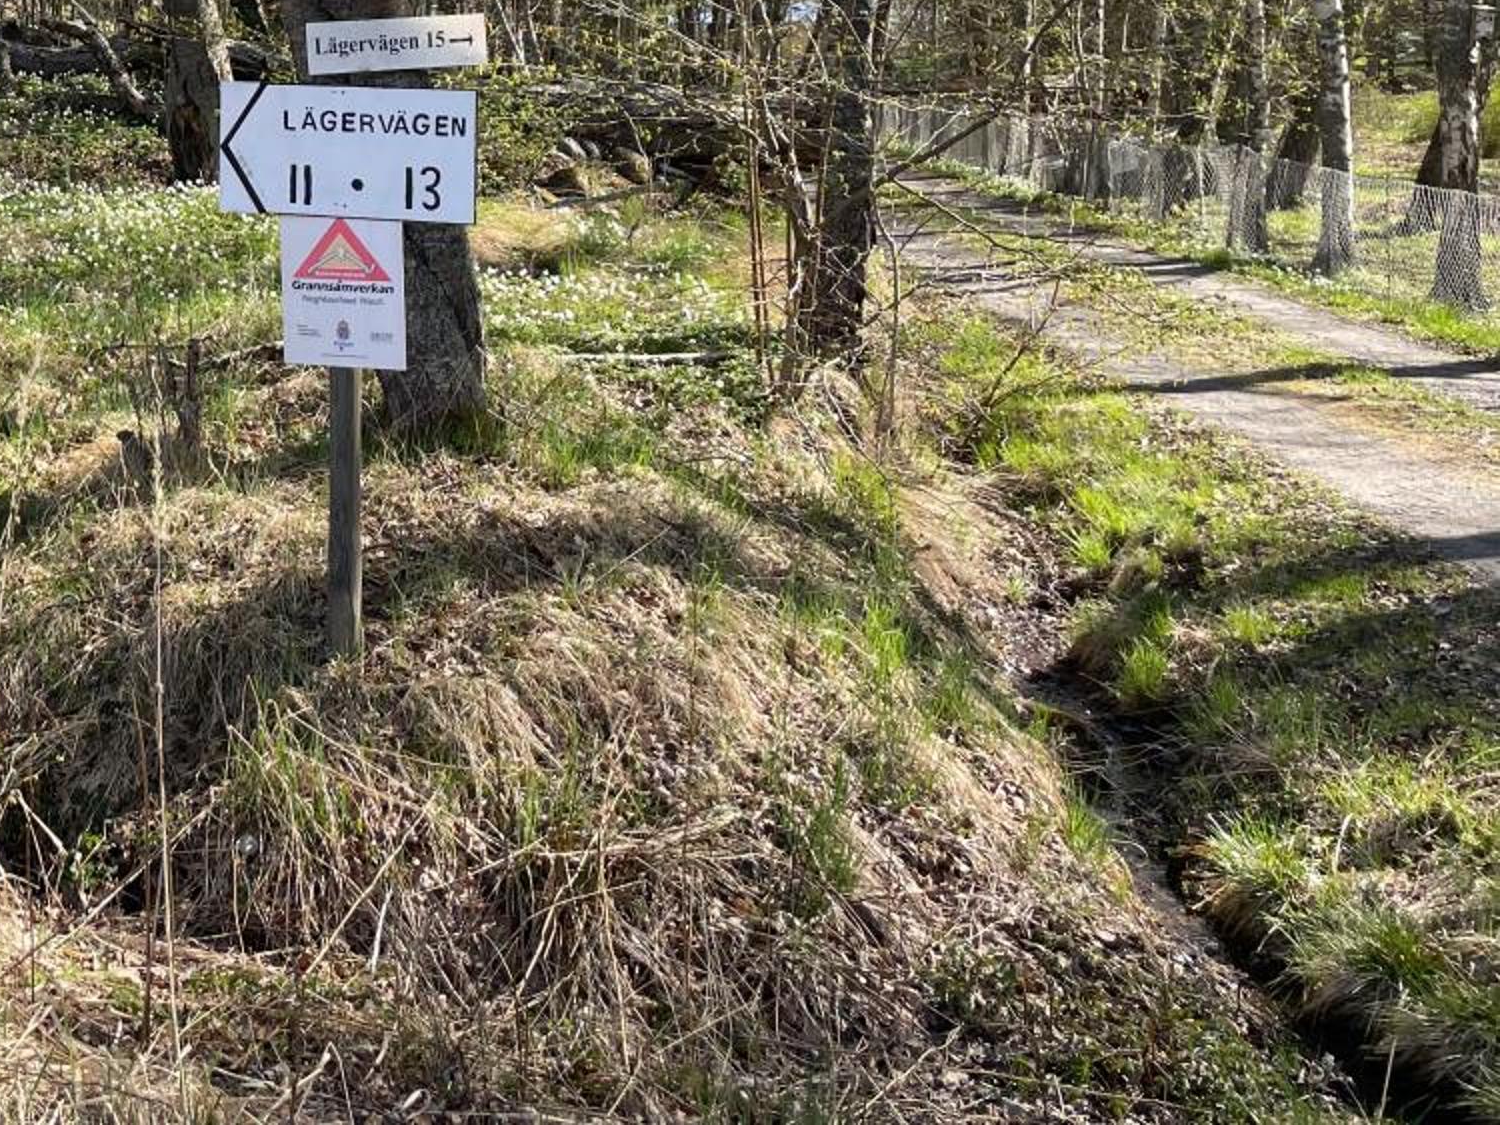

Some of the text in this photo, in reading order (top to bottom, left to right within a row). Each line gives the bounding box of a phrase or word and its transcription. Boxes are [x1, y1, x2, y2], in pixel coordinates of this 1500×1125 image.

[315, 31, 445, 57] Lägervägen 15
[283, 106, 467, 137] LÄGERVÄGEN
[289, 164, 442, 211] 11 13
